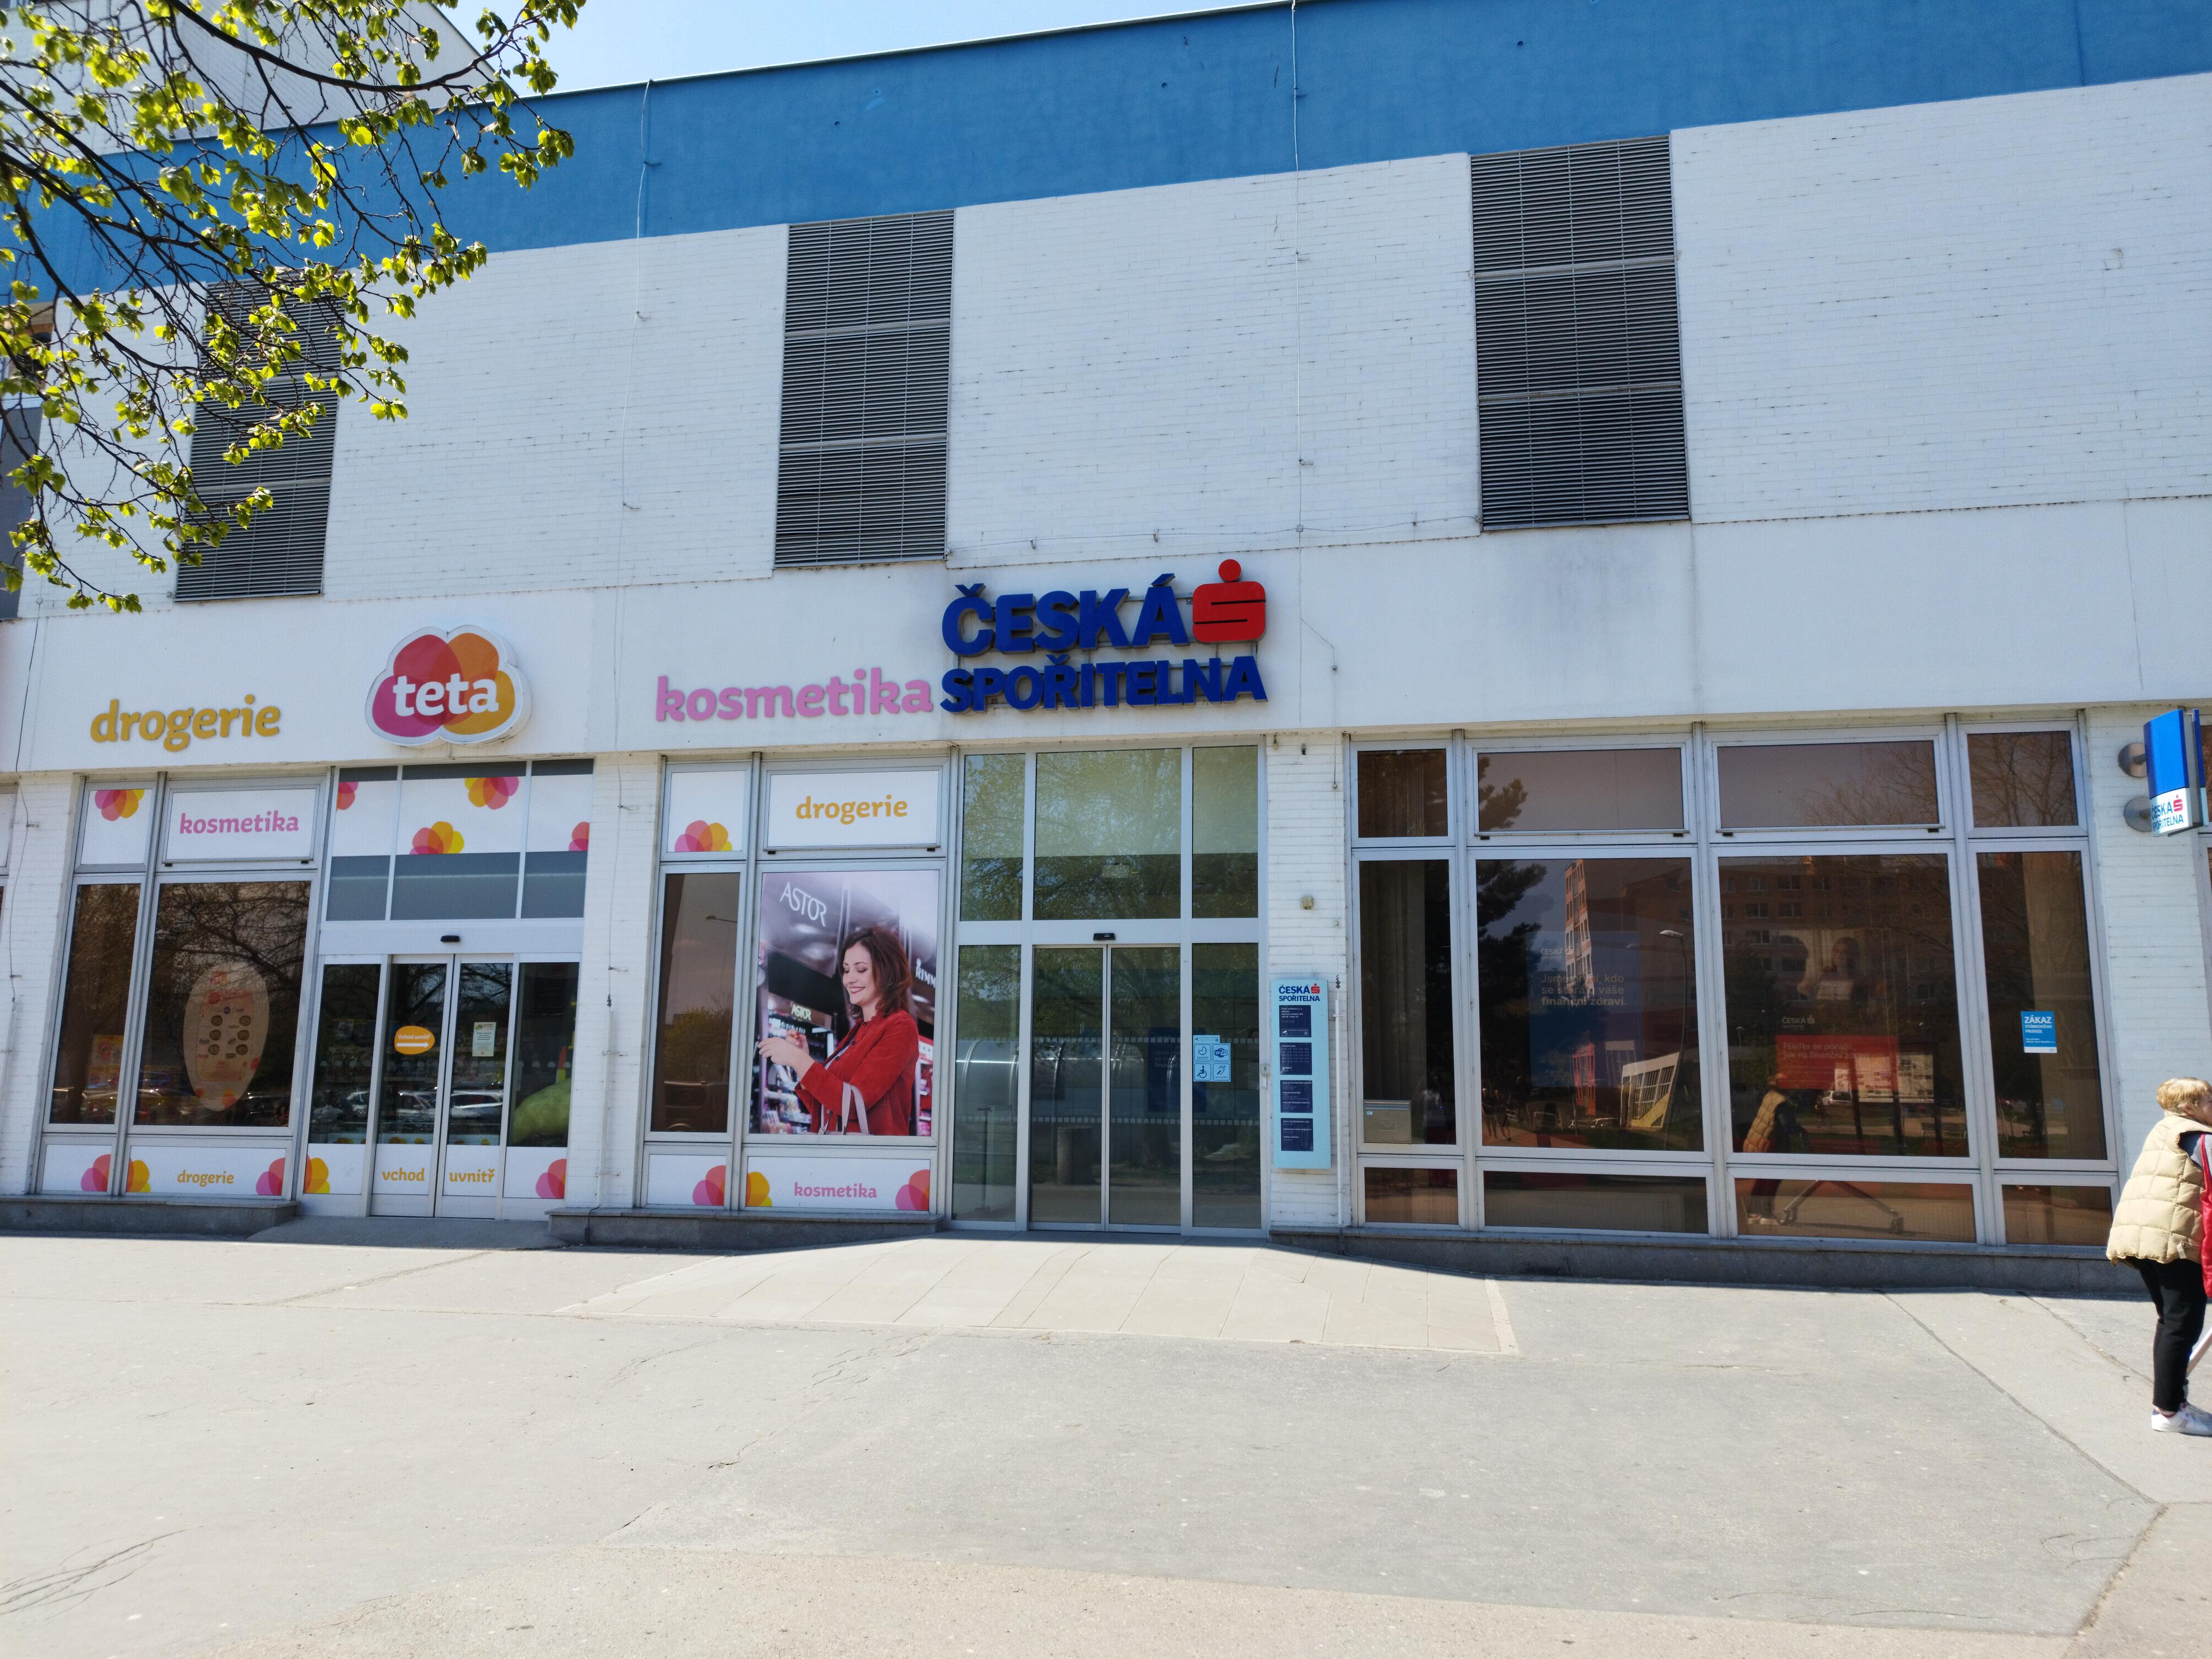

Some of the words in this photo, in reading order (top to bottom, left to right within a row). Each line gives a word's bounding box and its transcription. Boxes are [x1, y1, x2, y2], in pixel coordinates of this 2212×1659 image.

[942, 573, 1190, 656] ČESKÁ
[393, 673, 499, 716] teta
[656, 667, 933, 721] kosmetika
[940, 654, 1267, 713] SPOŘITELNA
[91, 695, 280, 752] drogerie
[796, 795, 907, 825] drogerie
[180, 811, 299, 834] kosmetika
[779, 881, 827, 927] ASTOR
[1599, 985, 1624, 994] vaše
[1605, 974, 1624, 983] kdo
[791, 1004, 811, 1021] ASTOR
[2025, 1015, 2052, 1024] ZÁKAZ
[177, 1169, 235, 1186] drogerie
[382, 1167, 425, 1182] vchod
[449, 1168, 495, 1183] uvnitř
[794, 1182, 878, 1198] kosmetika
